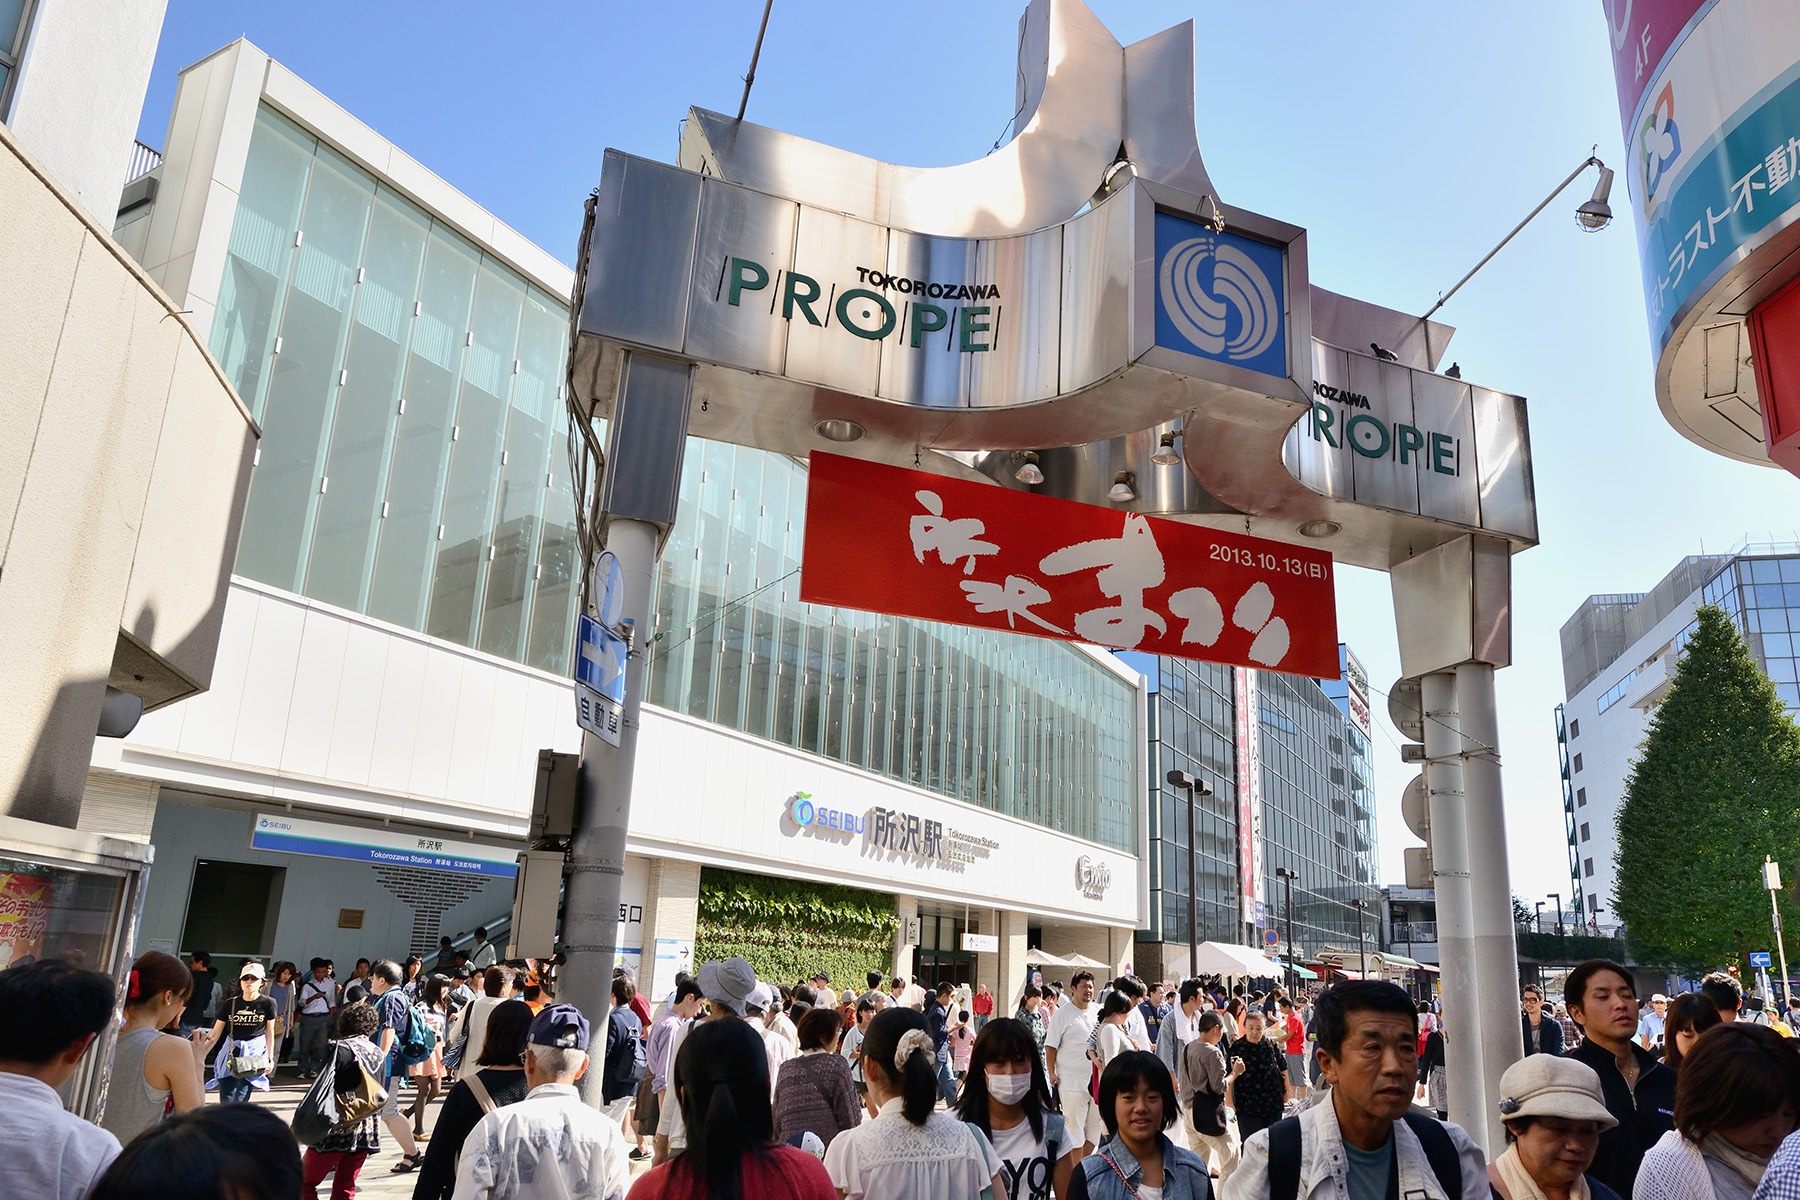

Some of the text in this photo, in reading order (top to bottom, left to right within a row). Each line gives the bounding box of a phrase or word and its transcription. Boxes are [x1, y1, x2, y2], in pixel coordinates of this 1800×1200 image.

[1635, 23, 1651, 84] 4F
[856, 266, 1001, 300] TOKOROZAWA
[728, 256, 991, 353] PROPE
[269, 821, 292, 831] SEIBU
[817, 806, 865, 835] SEIBU
[873, 806, 943, 860] 所沢駅
[417, 838, 443, 851] 所沢駅
[949, 828, 1000, 850] Tokorozawa Station
[370, 850, 433, 864] Tokorozawa Station
[0, 919, 47, 940] 欺かも!?
